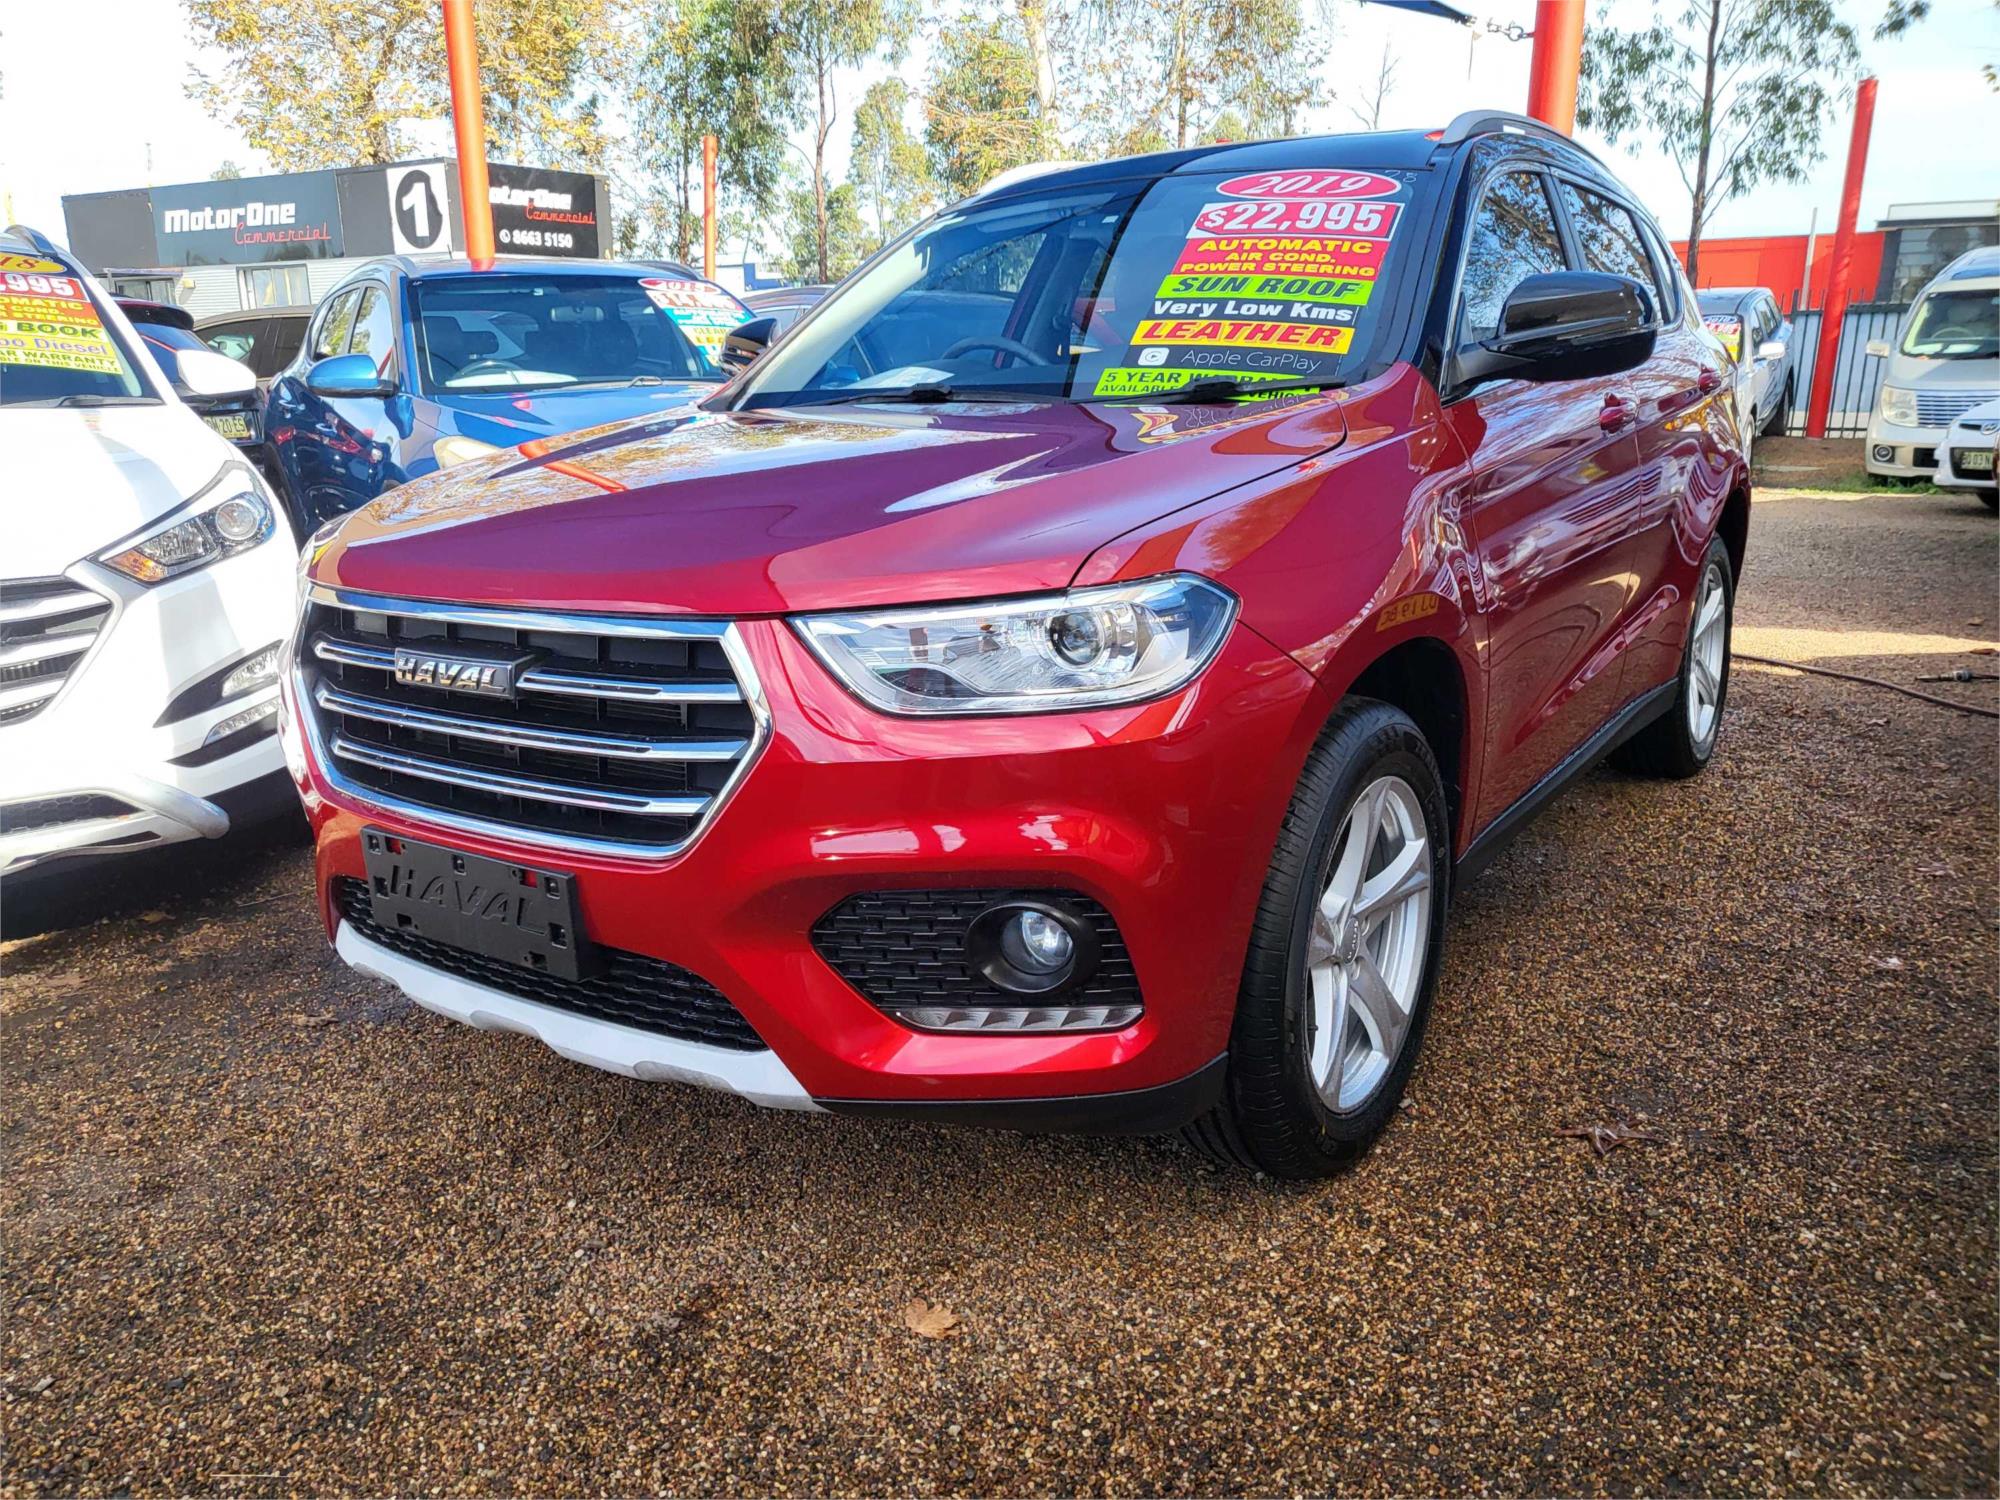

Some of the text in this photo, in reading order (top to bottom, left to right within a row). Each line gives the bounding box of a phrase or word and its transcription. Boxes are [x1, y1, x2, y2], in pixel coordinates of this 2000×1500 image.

[1239, 175, 1372, 194] 2019
[488, 185, 572, 210] otorOne
[402, 182, 429, 237] 1
[525, 200, 596, 225] Commercial
[1203, 202, 1386, 232] $22,995
[234, 221, 332, 245] Commercial
[1197, 239, 1373, 254] AUTOMATIC
[1225, 252, 1336, 264] AIR COND.
[1180, 263, 1376, 277] POWER STEERING
[1172, 277, 1362, 298] SUN ROOF
[1154, 300, 1354, 321] Very Low Kms
[16, 322, 100, 339] BOOK
[1142, 322, 1343, 346] LEATHER
[33, 337, 108, 355] Diesel
[1181, 350, 1322, 373] Apple CarPlay
[1105, 372, 1118, 382] 5
[1126, 372, 1182, 383] YEAR
[395, 658, 505, 692] HAVAL
[390, 864, 549, 937] HAVAL
